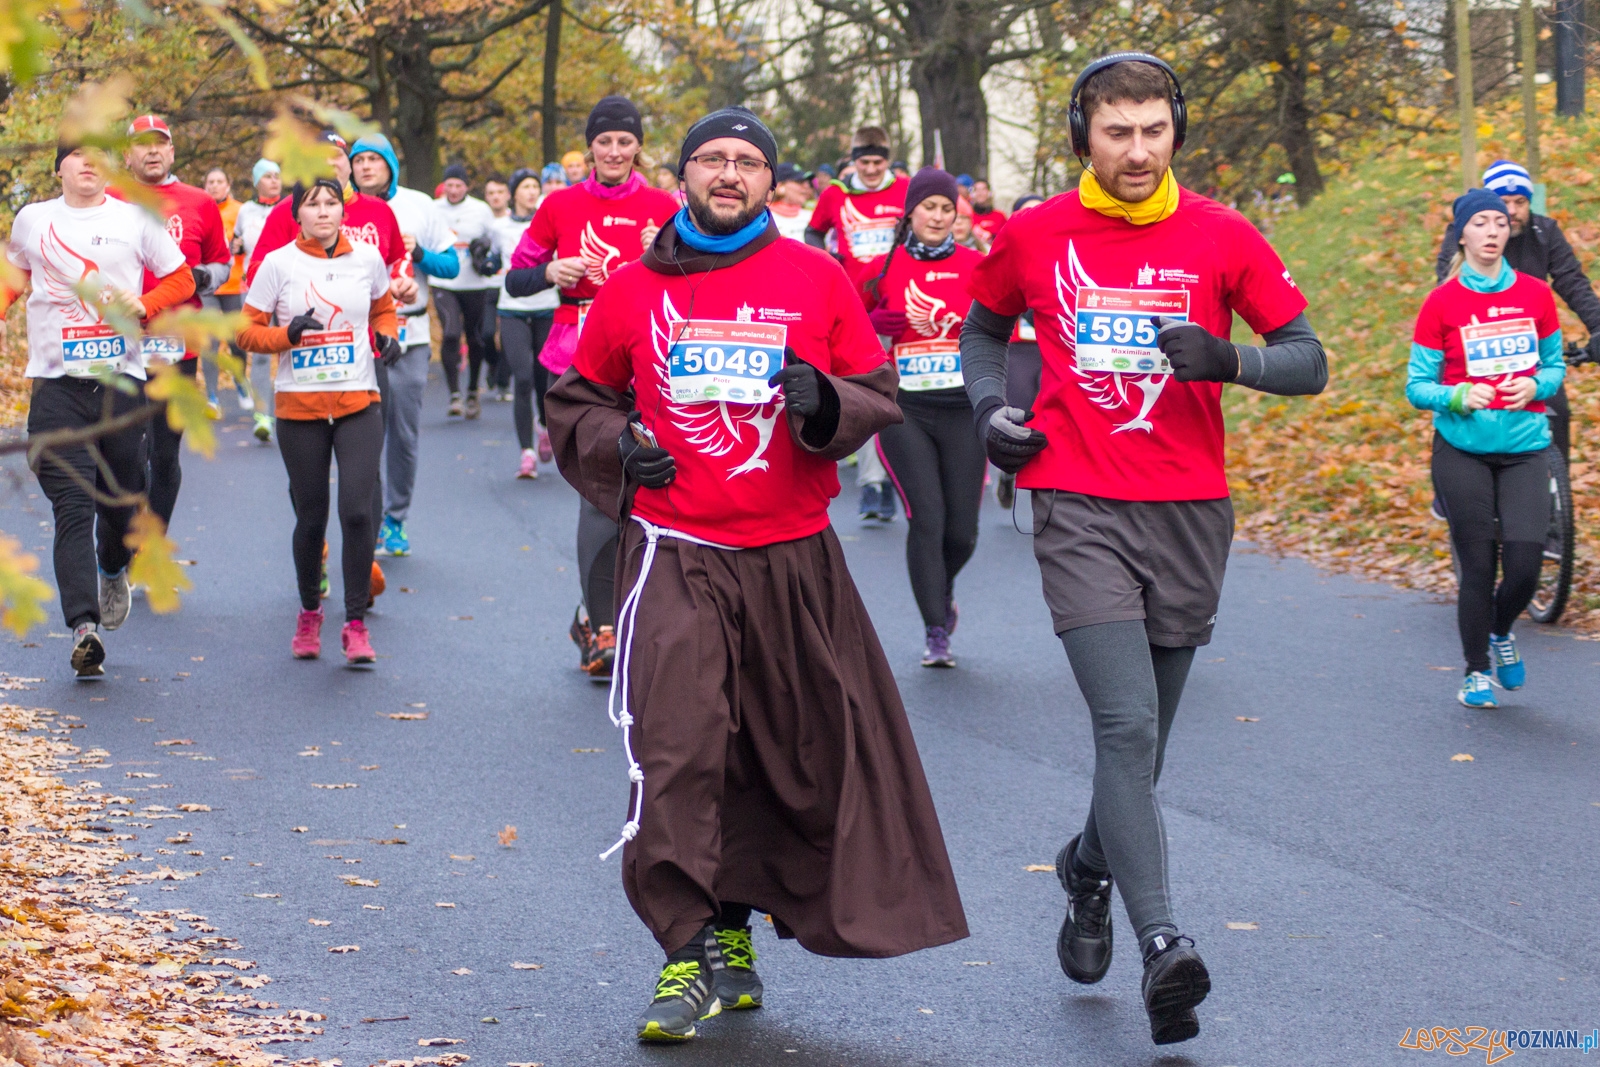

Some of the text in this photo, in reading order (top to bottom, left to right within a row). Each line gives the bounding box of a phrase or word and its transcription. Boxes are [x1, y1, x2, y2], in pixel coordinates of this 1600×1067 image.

[1139, 300, 1182, 309] RunPoland.org
[1079, 323, 1086, 333] E
[731, 331, 777, 341] RunPoland.org
[72, 338, 122, 358] 4996
[1111, 347, 1151, 356] Maximilian
[1476, 336, 1530, 358] 1199
[300, 346, 350, 367] 7459
[673, 347, 770, 376] E 5049
[905, 355, 957, 374] 4079
[713, 376, 731, 384] Piotr
